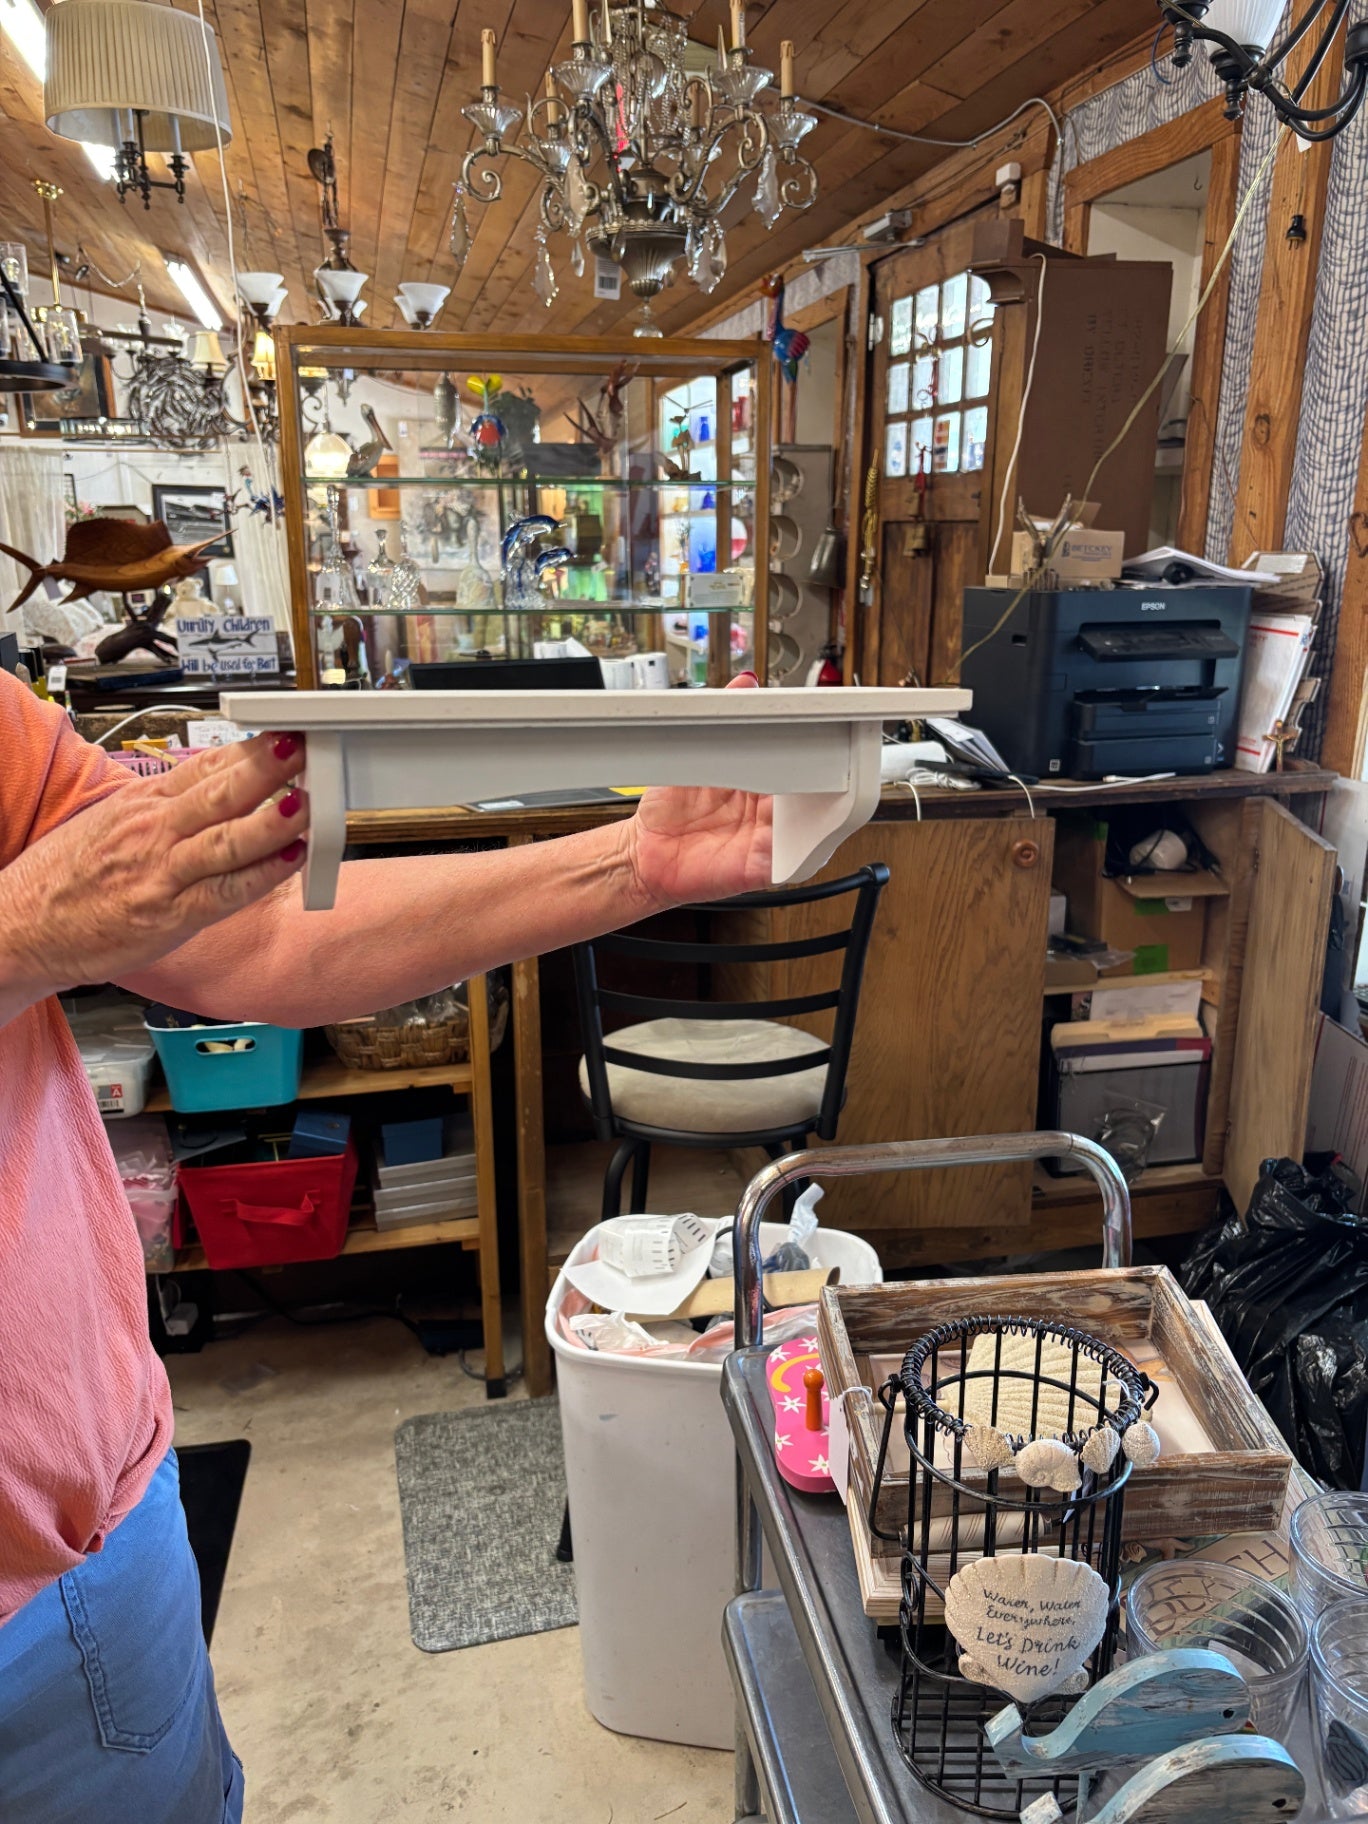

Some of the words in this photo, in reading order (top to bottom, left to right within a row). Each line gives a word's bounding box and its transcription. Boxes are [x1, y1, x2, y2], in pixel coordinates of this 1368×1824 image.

[1141, 602, 1166, 611] EPSON
[223, 618, 270, 632] Children
[203, 658, 218, 672] be
[257, 657, 275, 670] Bait
[976, 1626, 1013, 1650] Let's
[1019, 1635, 1081, 1653] Drink
[997, 1655, 1060, 1676] Wine!
